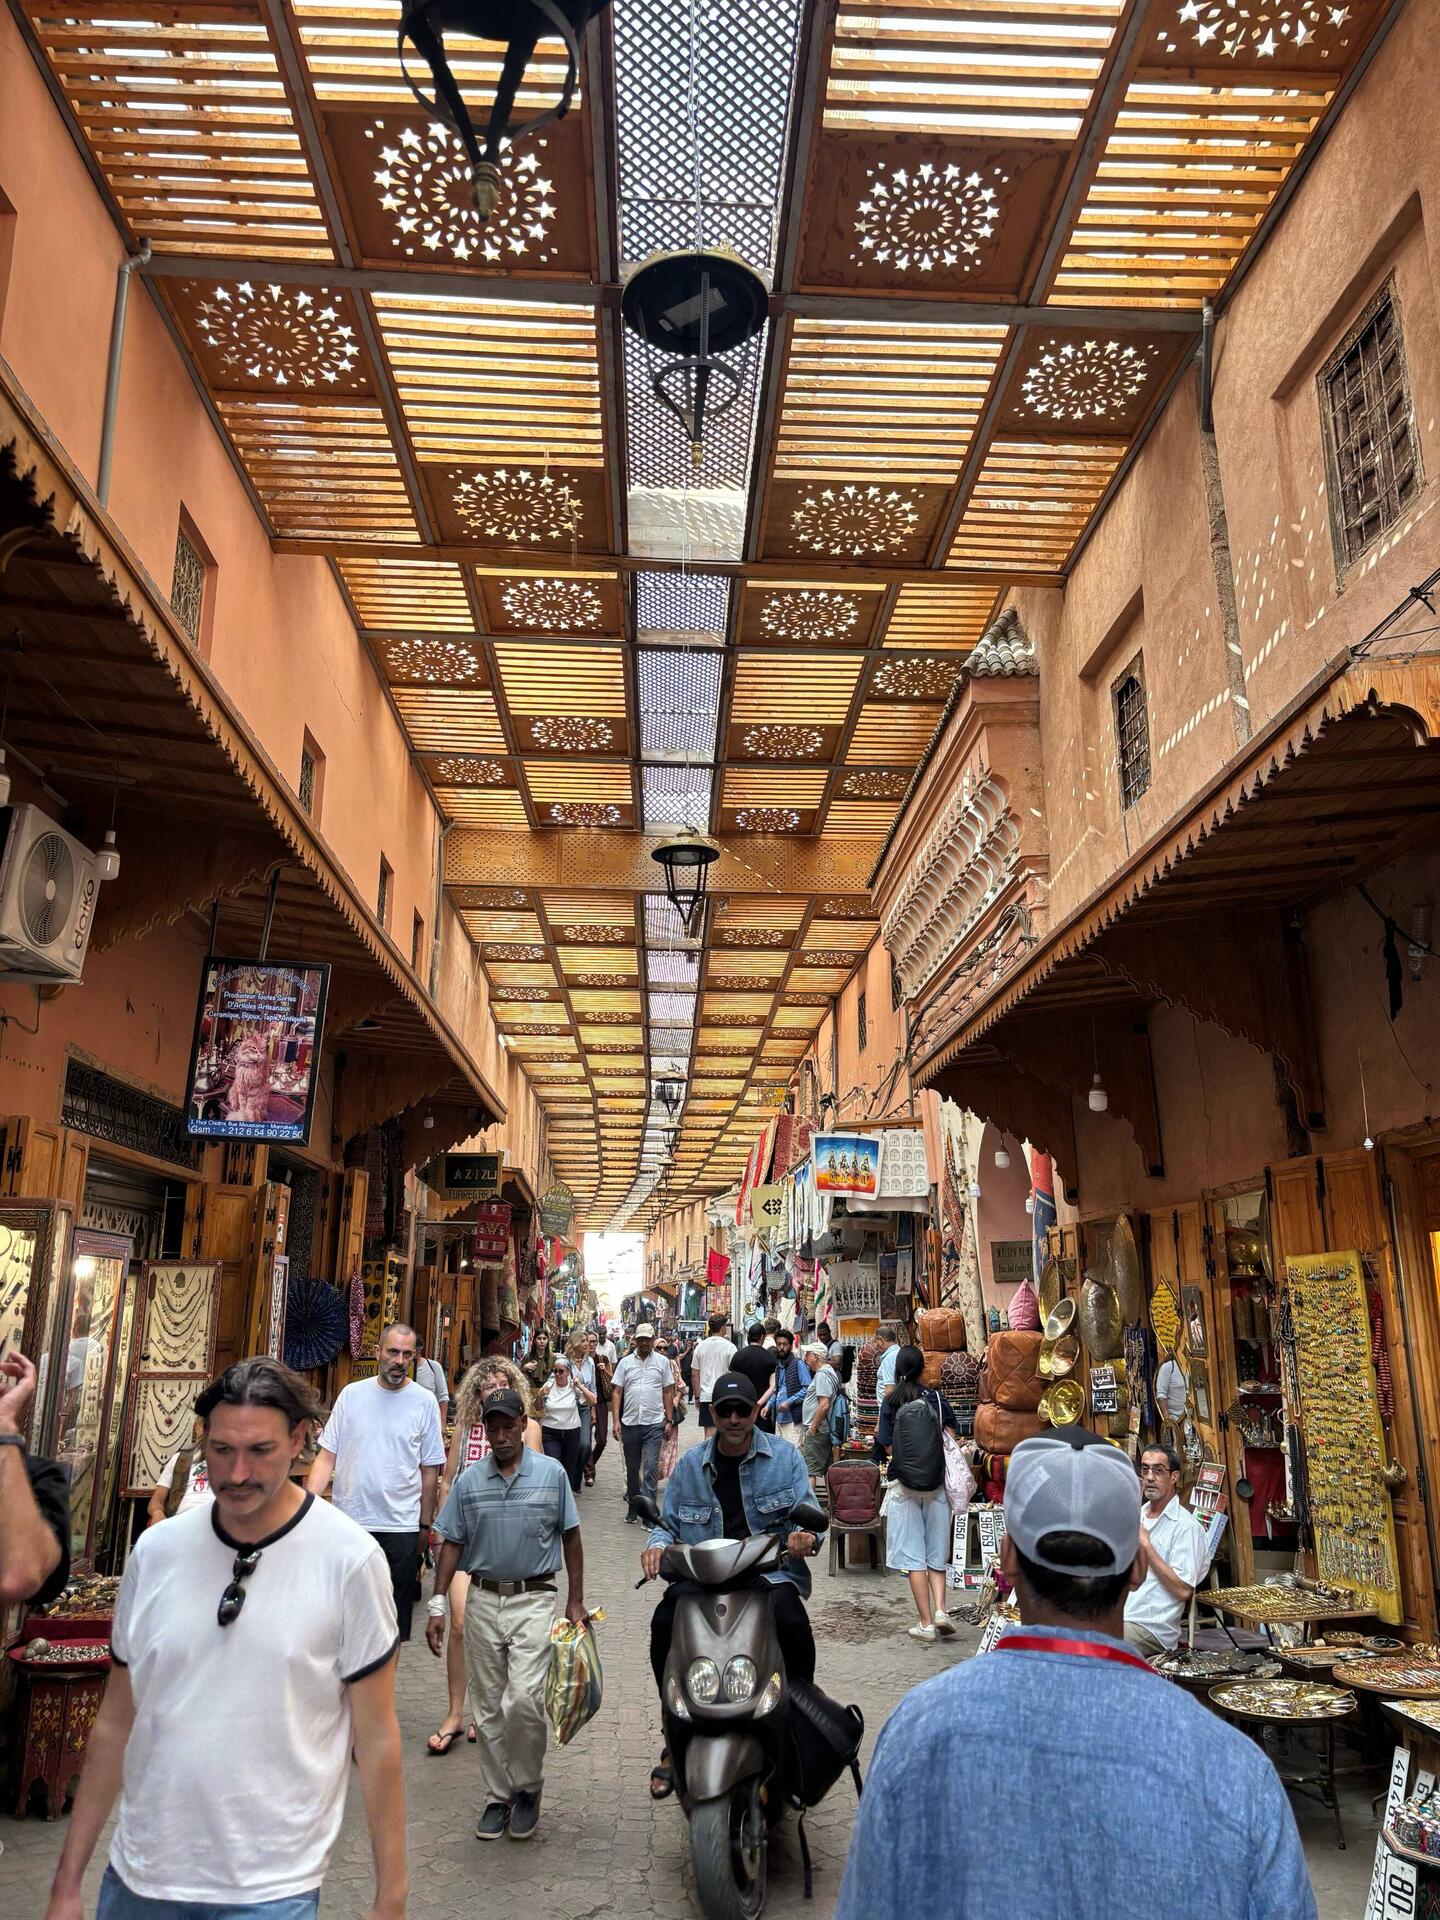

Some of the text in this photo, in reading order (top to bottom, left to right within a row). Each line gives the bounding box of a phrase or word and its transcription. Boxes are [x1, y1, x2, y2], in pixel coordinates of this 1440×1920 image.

[257, 992, 276, 1001] Toutes
[277, 994, 297, 1003] Sortes
[257, 1003, 290, 1012] Artisanaux
[190, 1125, 211, 1134] Gsm
[228, 1126, 245, 1136] 212
[253, 1128, 264, 1137] 54
[267, 1129, 278, 1137] 90
[279, 1130, 291, 1138] 22
[980, 1516, 995, 1547] 98769
[953, 1571, 963, 1584] 26
